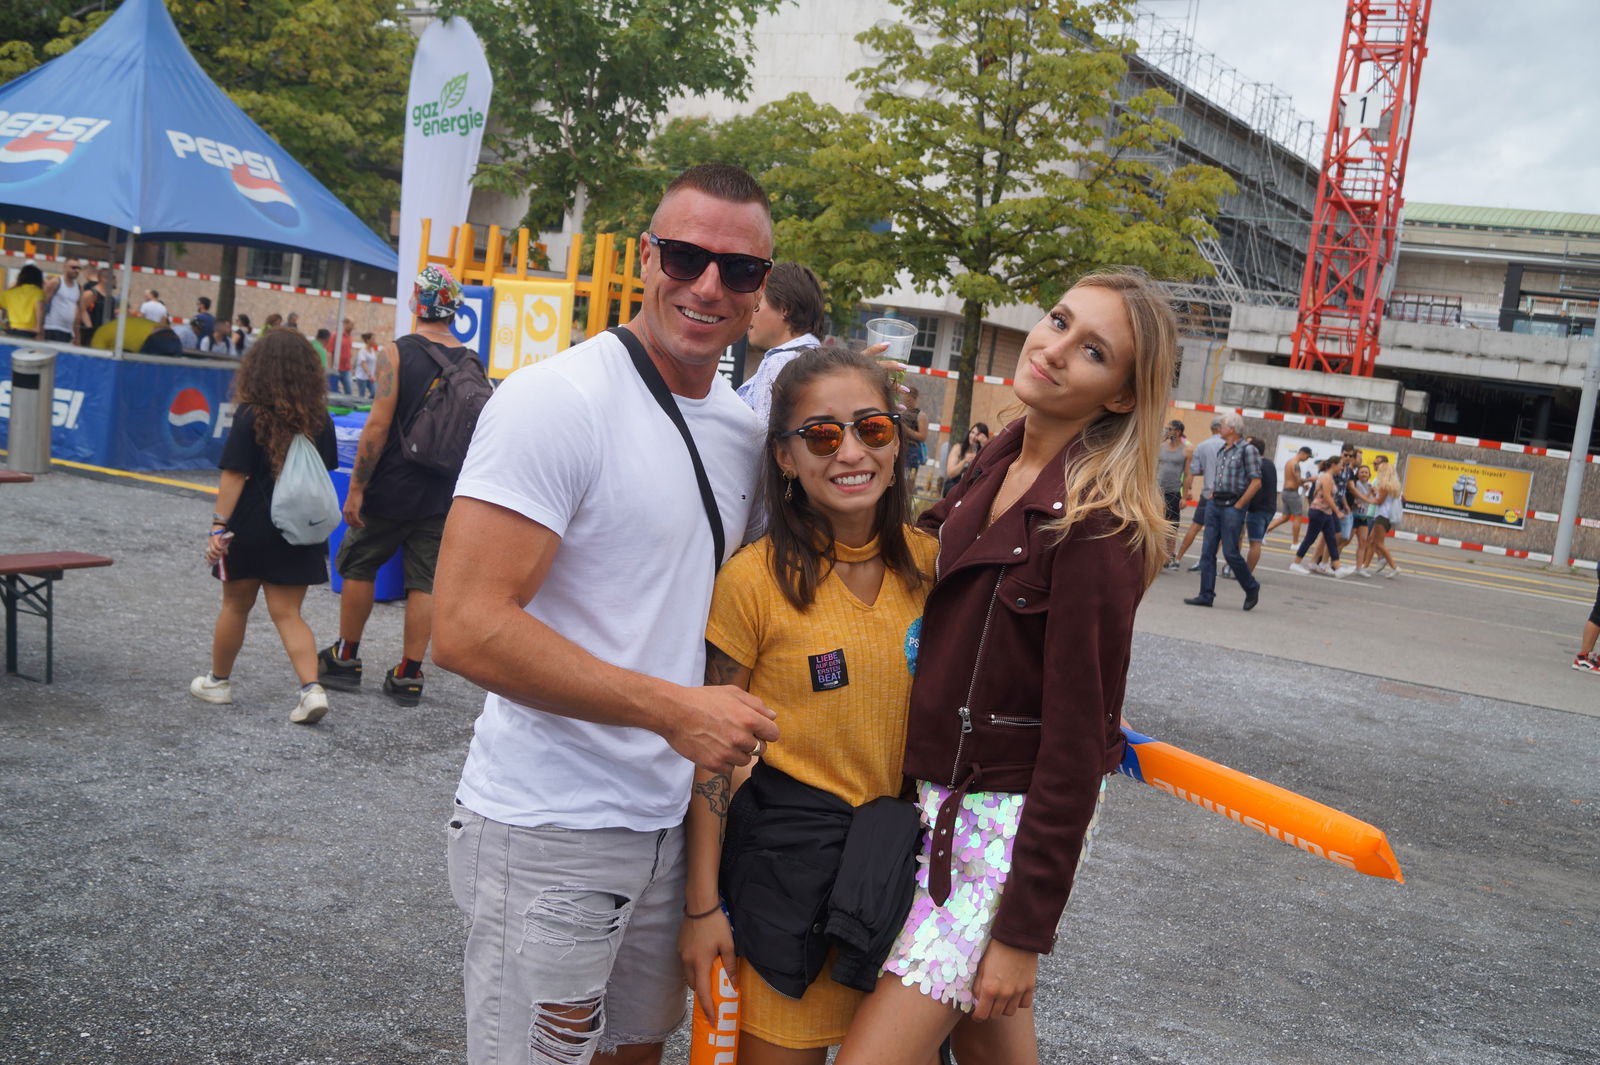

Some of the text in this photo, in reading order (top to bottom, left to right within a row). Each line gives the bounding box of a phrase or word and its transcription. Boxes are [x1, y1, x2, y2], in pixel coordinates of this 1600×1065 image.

[412, 101, 439, 127] gaz
[422, 106, 484, 136] energie
[1360, 96, 1367, 124] 1
[165, 129, 282, 183] PEPSI
[816, 651, 838, 663] LIEBE
[818, 670, 841, 683] BEAT
